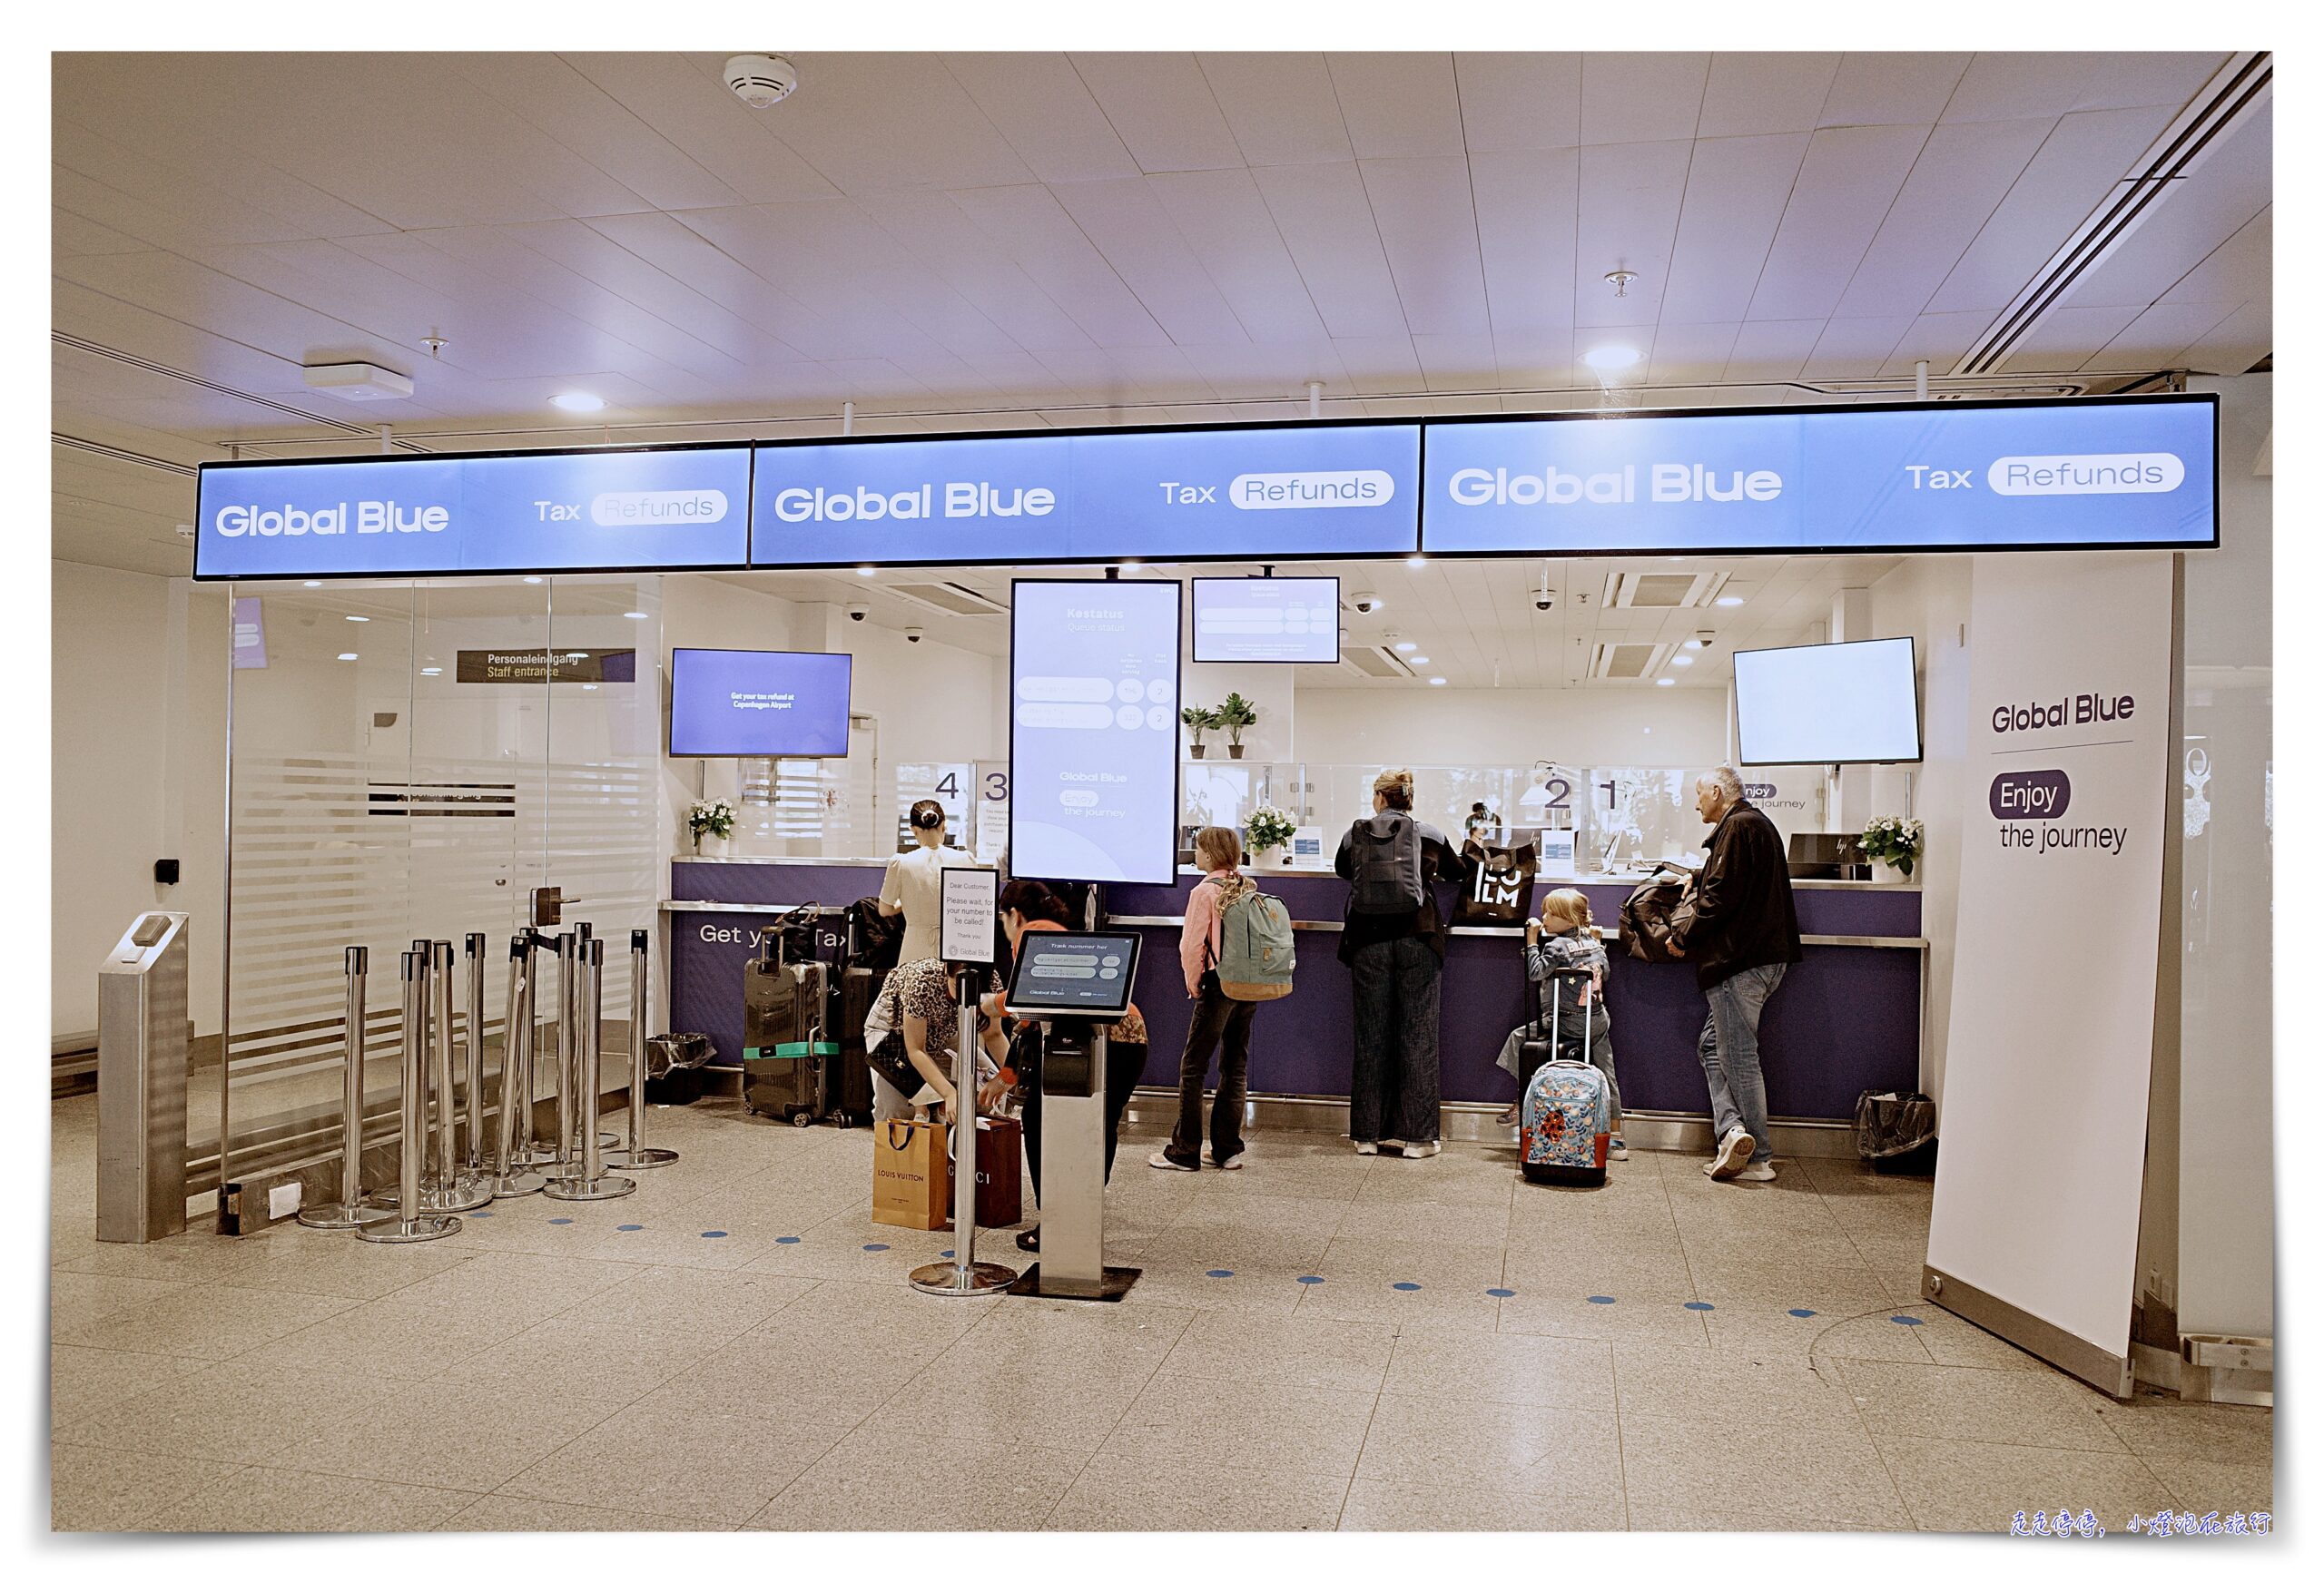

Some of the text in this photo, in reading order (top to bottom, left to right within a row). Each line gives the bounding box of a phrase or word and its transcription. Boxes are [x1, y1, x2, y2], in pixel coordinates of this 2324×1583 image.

[1448, 462, 1783, 506] Global Blue
[1905, 459, 2165, 490] Tax Refunds
[1159, 477, 1377, 506] Tax Refunds
[534, 496, 714, 523] Tax Refunds
[774, 481, 1056, 523] Global Blue
[215, 500, 449, 537] Global Blue
[487, 666, 511, 677] Staff
[731, 692, 743, 700] Get
[743, 693, 757, 702] your
[768, 693, 788, 701] refund
[734, 700, 793, 711] Copenhagen Airport
[1992, 693, 2135, 733] Global Blue
[935, 772, 959, 800] 4
[985, 772, 1008, 801] 3
[1059, 772, 1128, 783] Global Blue
[1065, 791, 1094, 805] Enoy
[1544, 779, 1571, 809] 2
[1600, 780, 1616, 810] 1
[1744, 786, 1770, 797] njoy
[2000, 781, 2058, 814] Enjoy
[1064, 806, 1126, 820] the journey
[1761, 799, 1806, 811] journey
[1999, 821, 2128, 856] the journey
[963, 883, 990, 891] Customer,
[946, 896, 968, 905] Please
[969, 898, 983, 906] wait,
[954, 917, 984, 926] be called!
[699, 924, 742, 943] Get
[960, 948, 990, 958] Global Blue
[877, 1169, 924, 1183] LOUIS VUITTON
[947, 1165, 990, 1185] GCI
